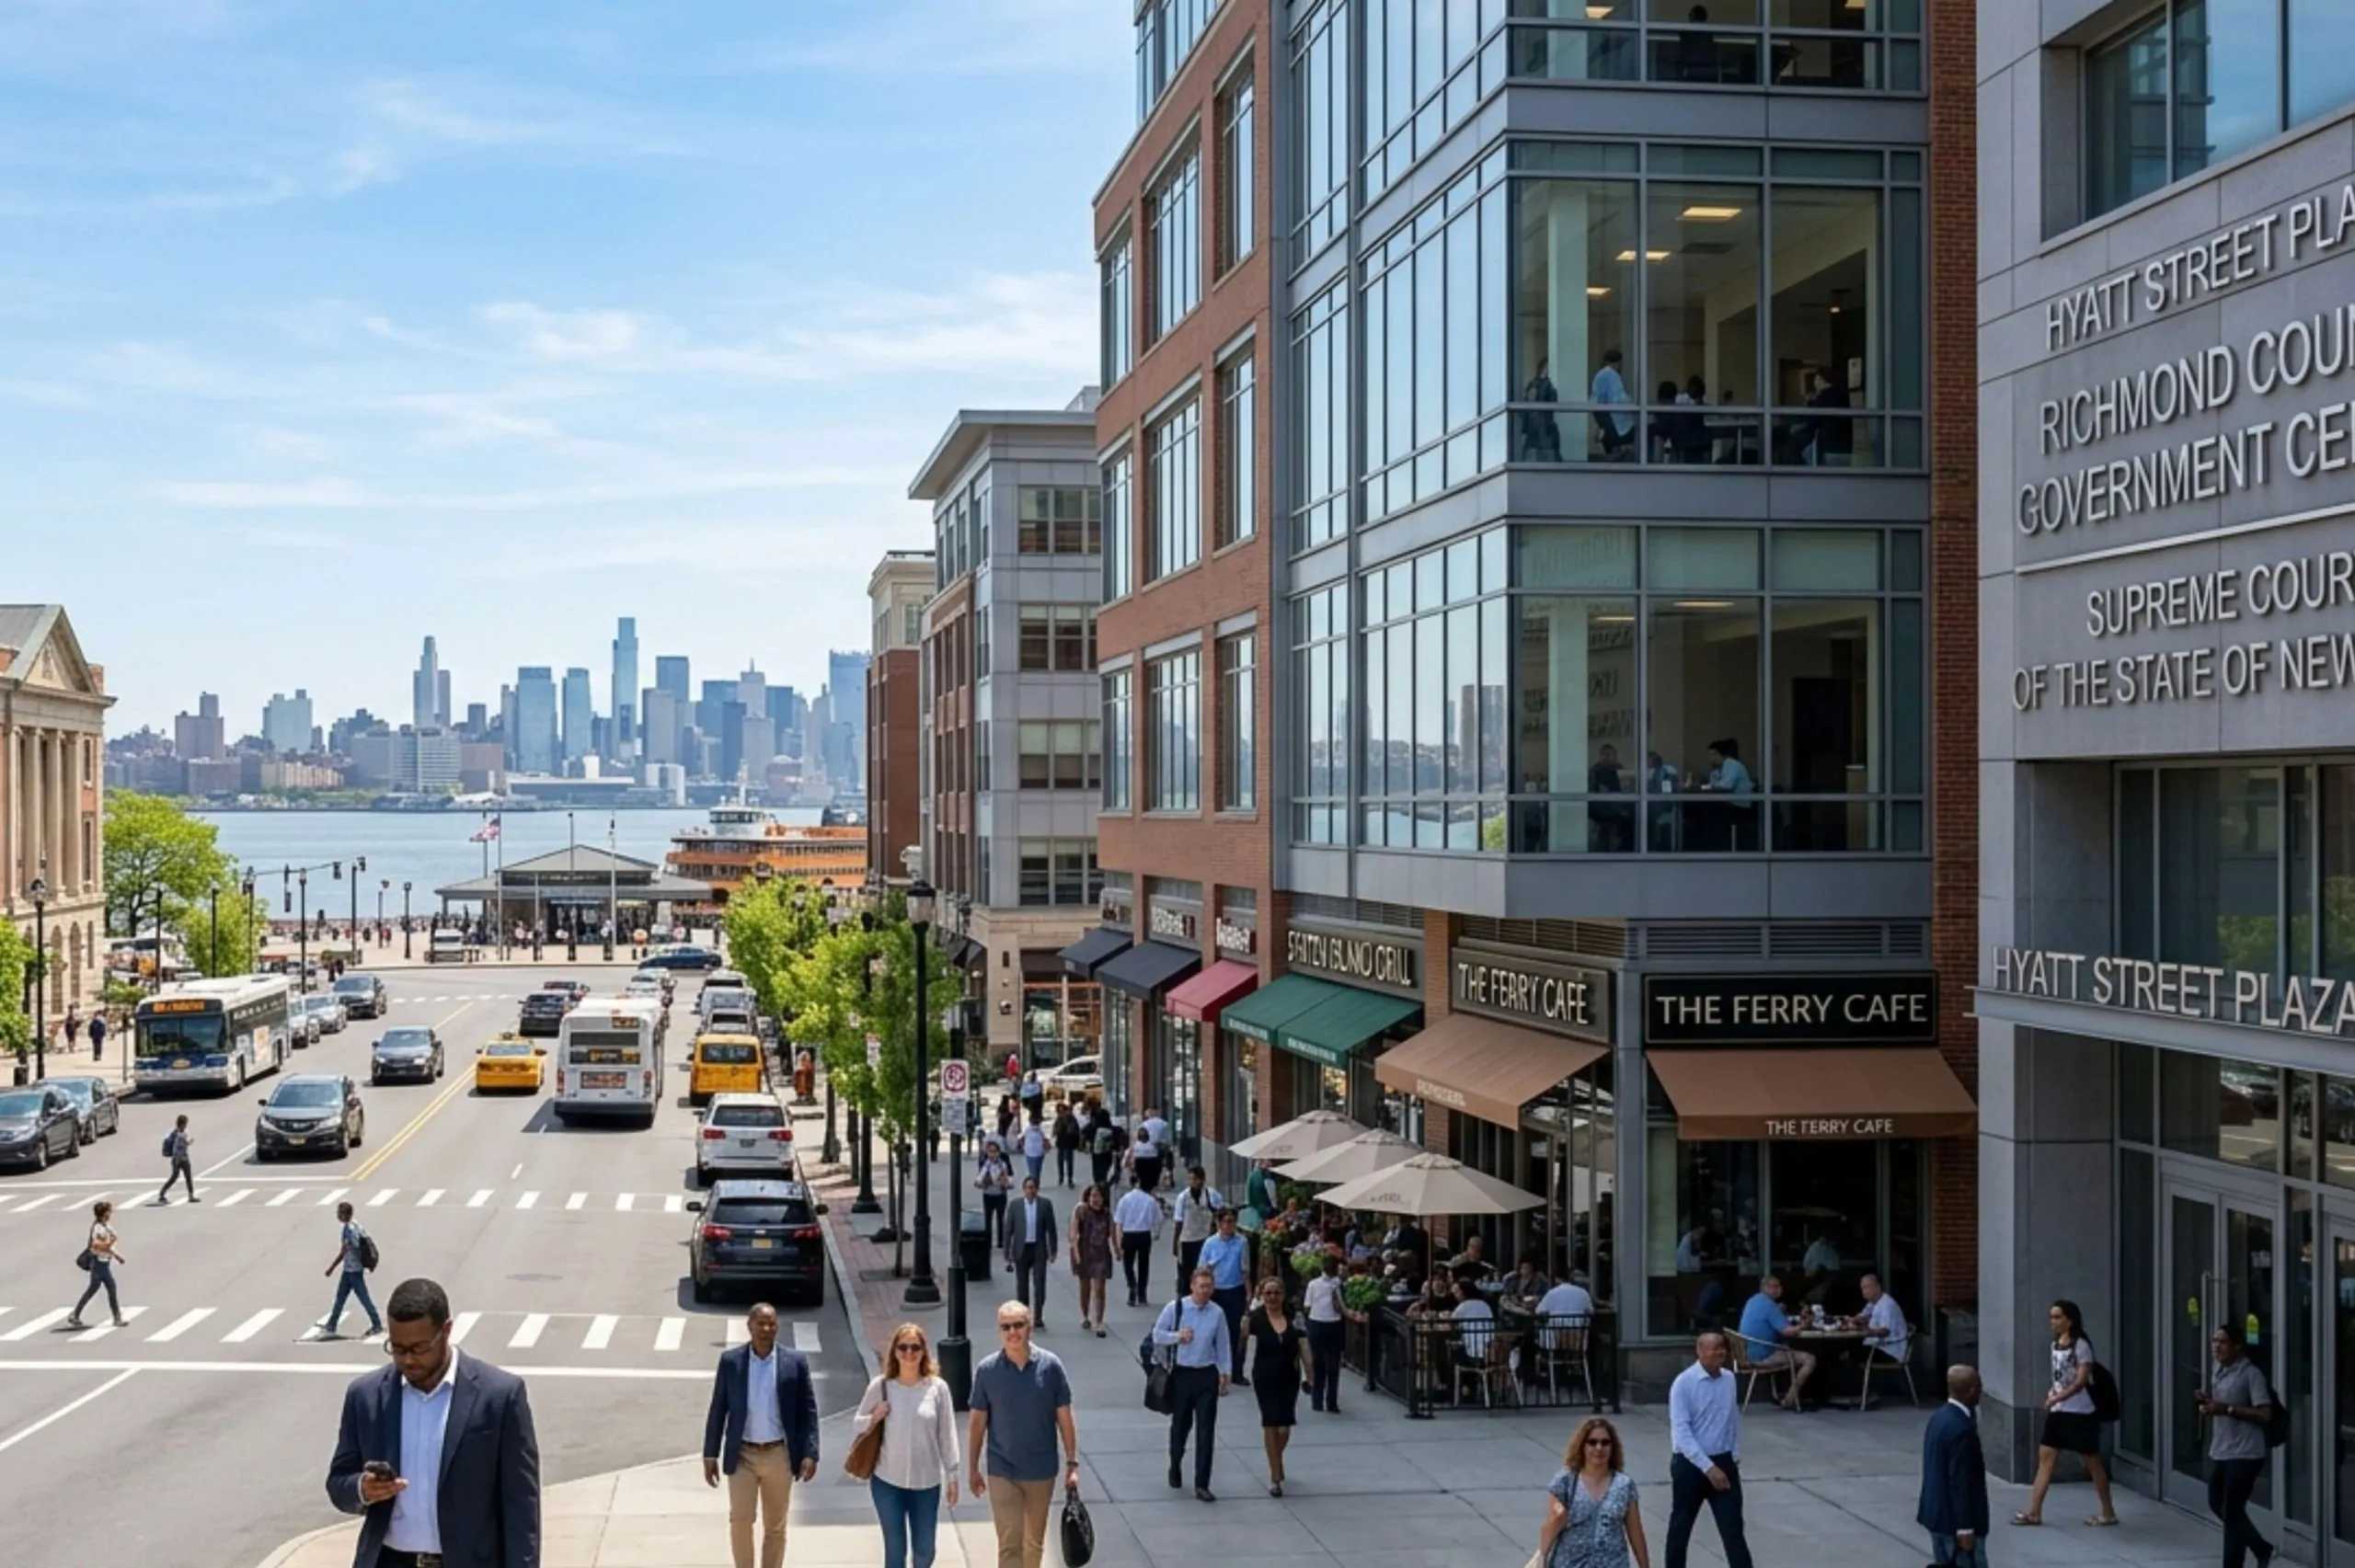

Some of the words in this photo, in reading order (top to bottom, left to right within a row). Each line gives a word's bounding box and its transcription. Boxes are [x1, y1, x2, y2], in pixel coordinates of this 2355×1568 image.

[2045, 269, 2140, 351] HYATT
[2144, 213, 2279, 312] STREET
[2289, 184, 2355, 258] PLA
[2039, 345, 2234, 455] RICHMOND
[2246, 303, 2355, 395] COU
[2016, 421, 2273, 534] GOVERNMENT
[2285, 401, 2355, 477] CE
[2086, 568, 2237, 637] SUPREME
[2013, 665, 2047, 711] OF
[2054, 658, 2109, 706] THE
[2116, 648, 2212, 703] STATE
[2222, 642, 2269, 696] OF
[2280, 632, 2355, 690] NEW
[1458, 963, 1487, 1003] THE
[1490, 967, 1540, 1013] FERRY
[1655, 995, 1722, 1024] THE
[1733, 994, 1833, 1024] FERRY
[1843, 993, 1928, 1023] CAFE
[1992, 946, 2085, 1001] HYATT
[2093, 956, 2224, 1019] STREET
[2235, 970, 2355, 1035] PLAZA
[1764, 1119, 1797, 1136] THE
